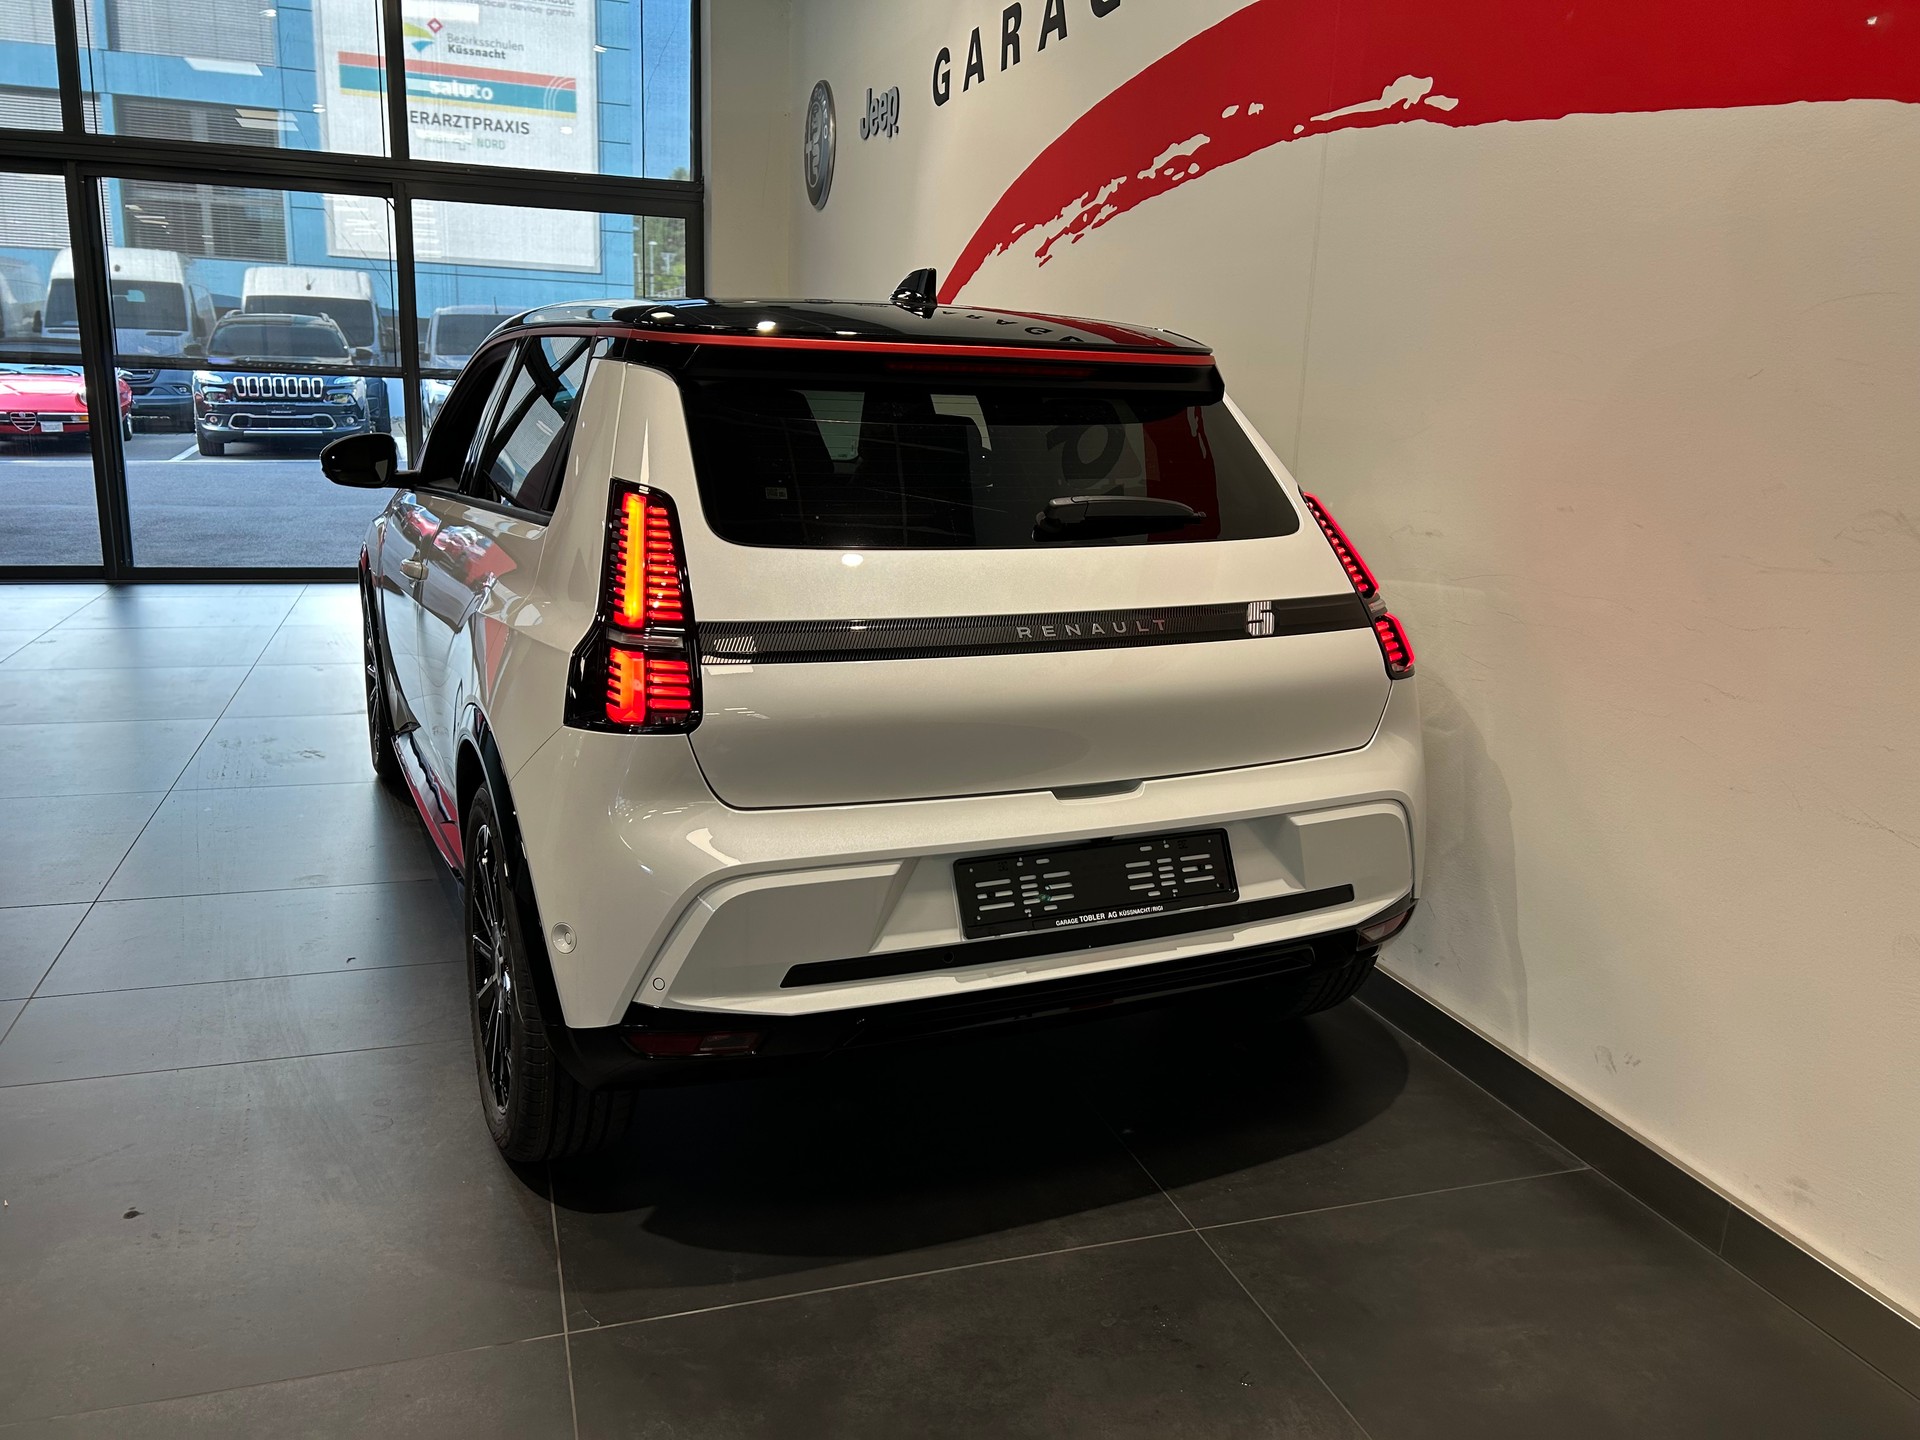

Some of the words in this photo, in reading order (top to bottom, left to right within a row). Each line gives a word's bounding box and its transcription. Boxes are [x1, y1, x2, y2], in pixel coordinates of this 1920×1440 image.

[446, 32, 525, 52] Bezirksschulen
[447, 43, 506, 60] Küssnacht
[931, 0, 1122, 107] GARA
[409, 109, 531, 136] ERARZTPRAXIS
[859, 86, 900, 141] Jeep
[1016, 619, 1166, 639] RENAULT
[1055, 917, 1079, 927] GARAGE
[1079, 912, 1106, 923] TOBLER
[1107, 910, 1118, 919] AG
